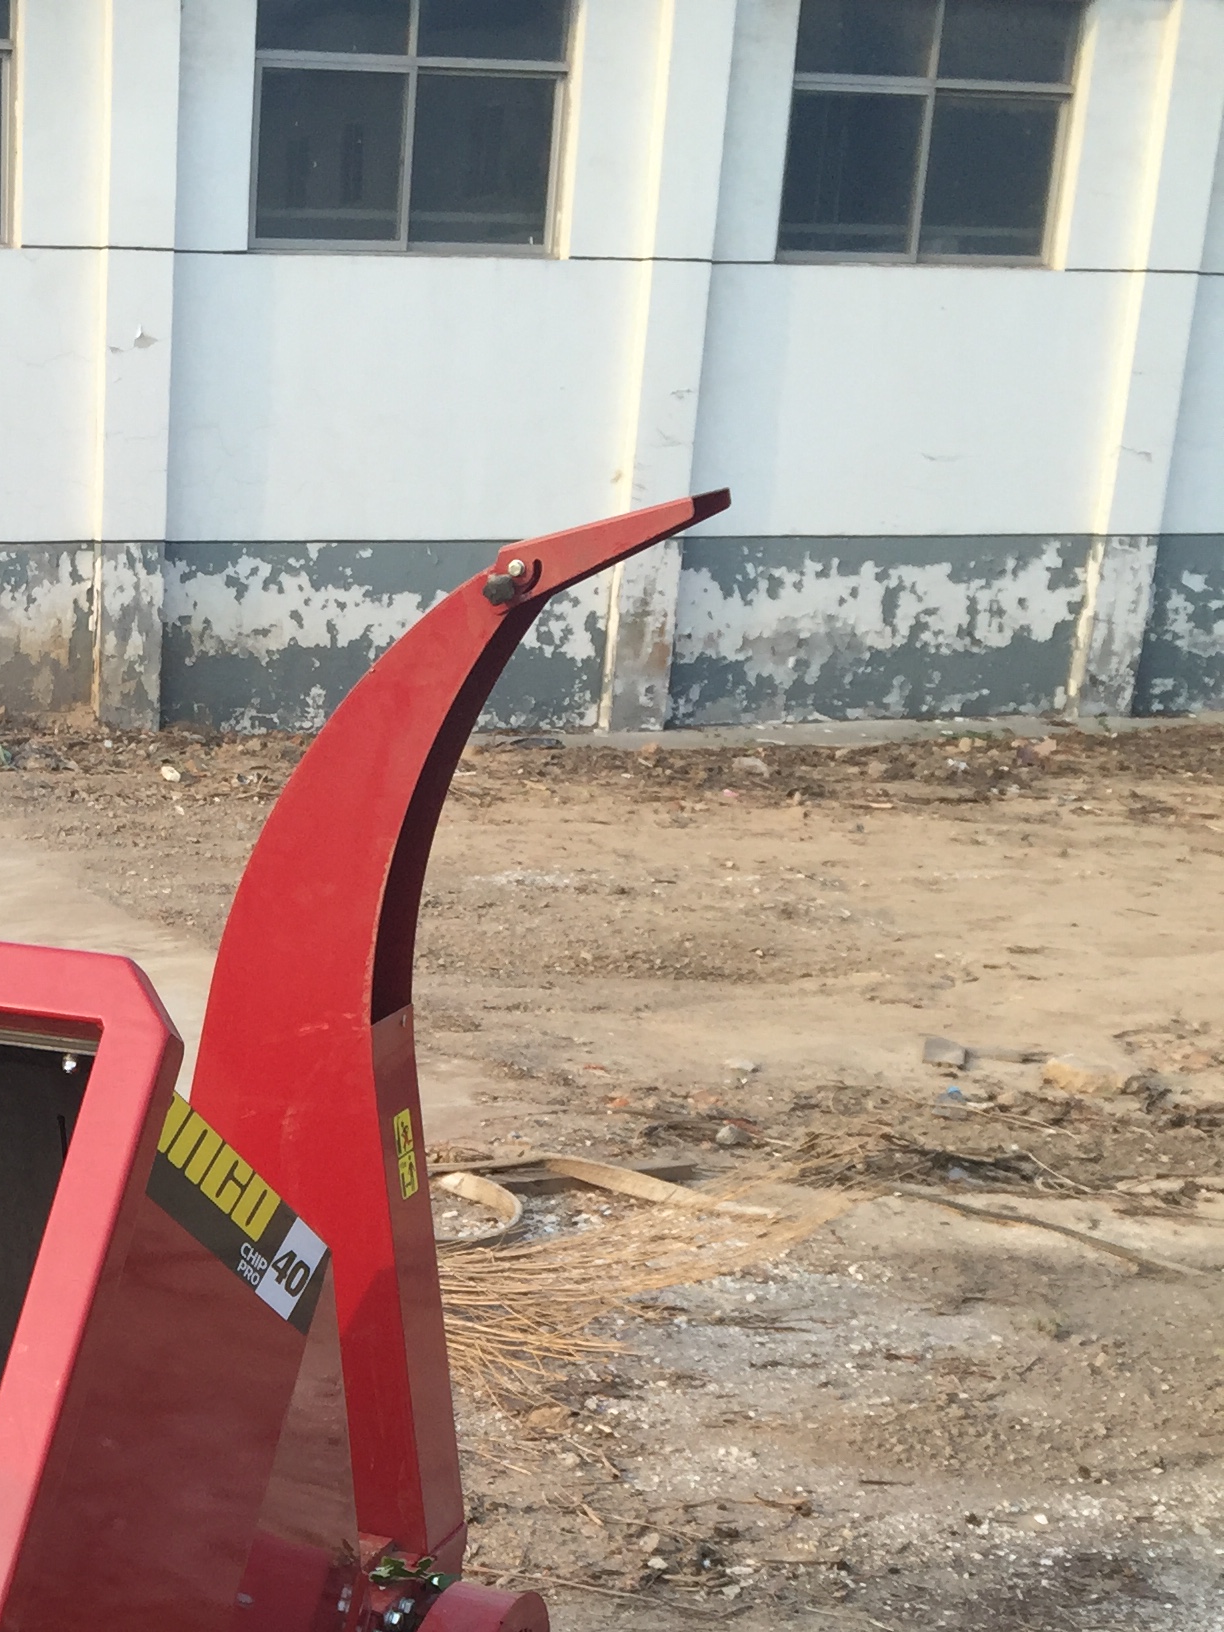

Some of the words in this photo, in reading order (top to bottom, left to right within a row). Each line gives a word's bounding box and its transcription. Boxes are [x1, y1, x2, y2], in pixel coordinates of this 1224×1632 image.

[239, 1242, 268, 1272] CHIP
[236, 1259, 261, 1286] PRO
[271, 1250, 311, 1298] 40
